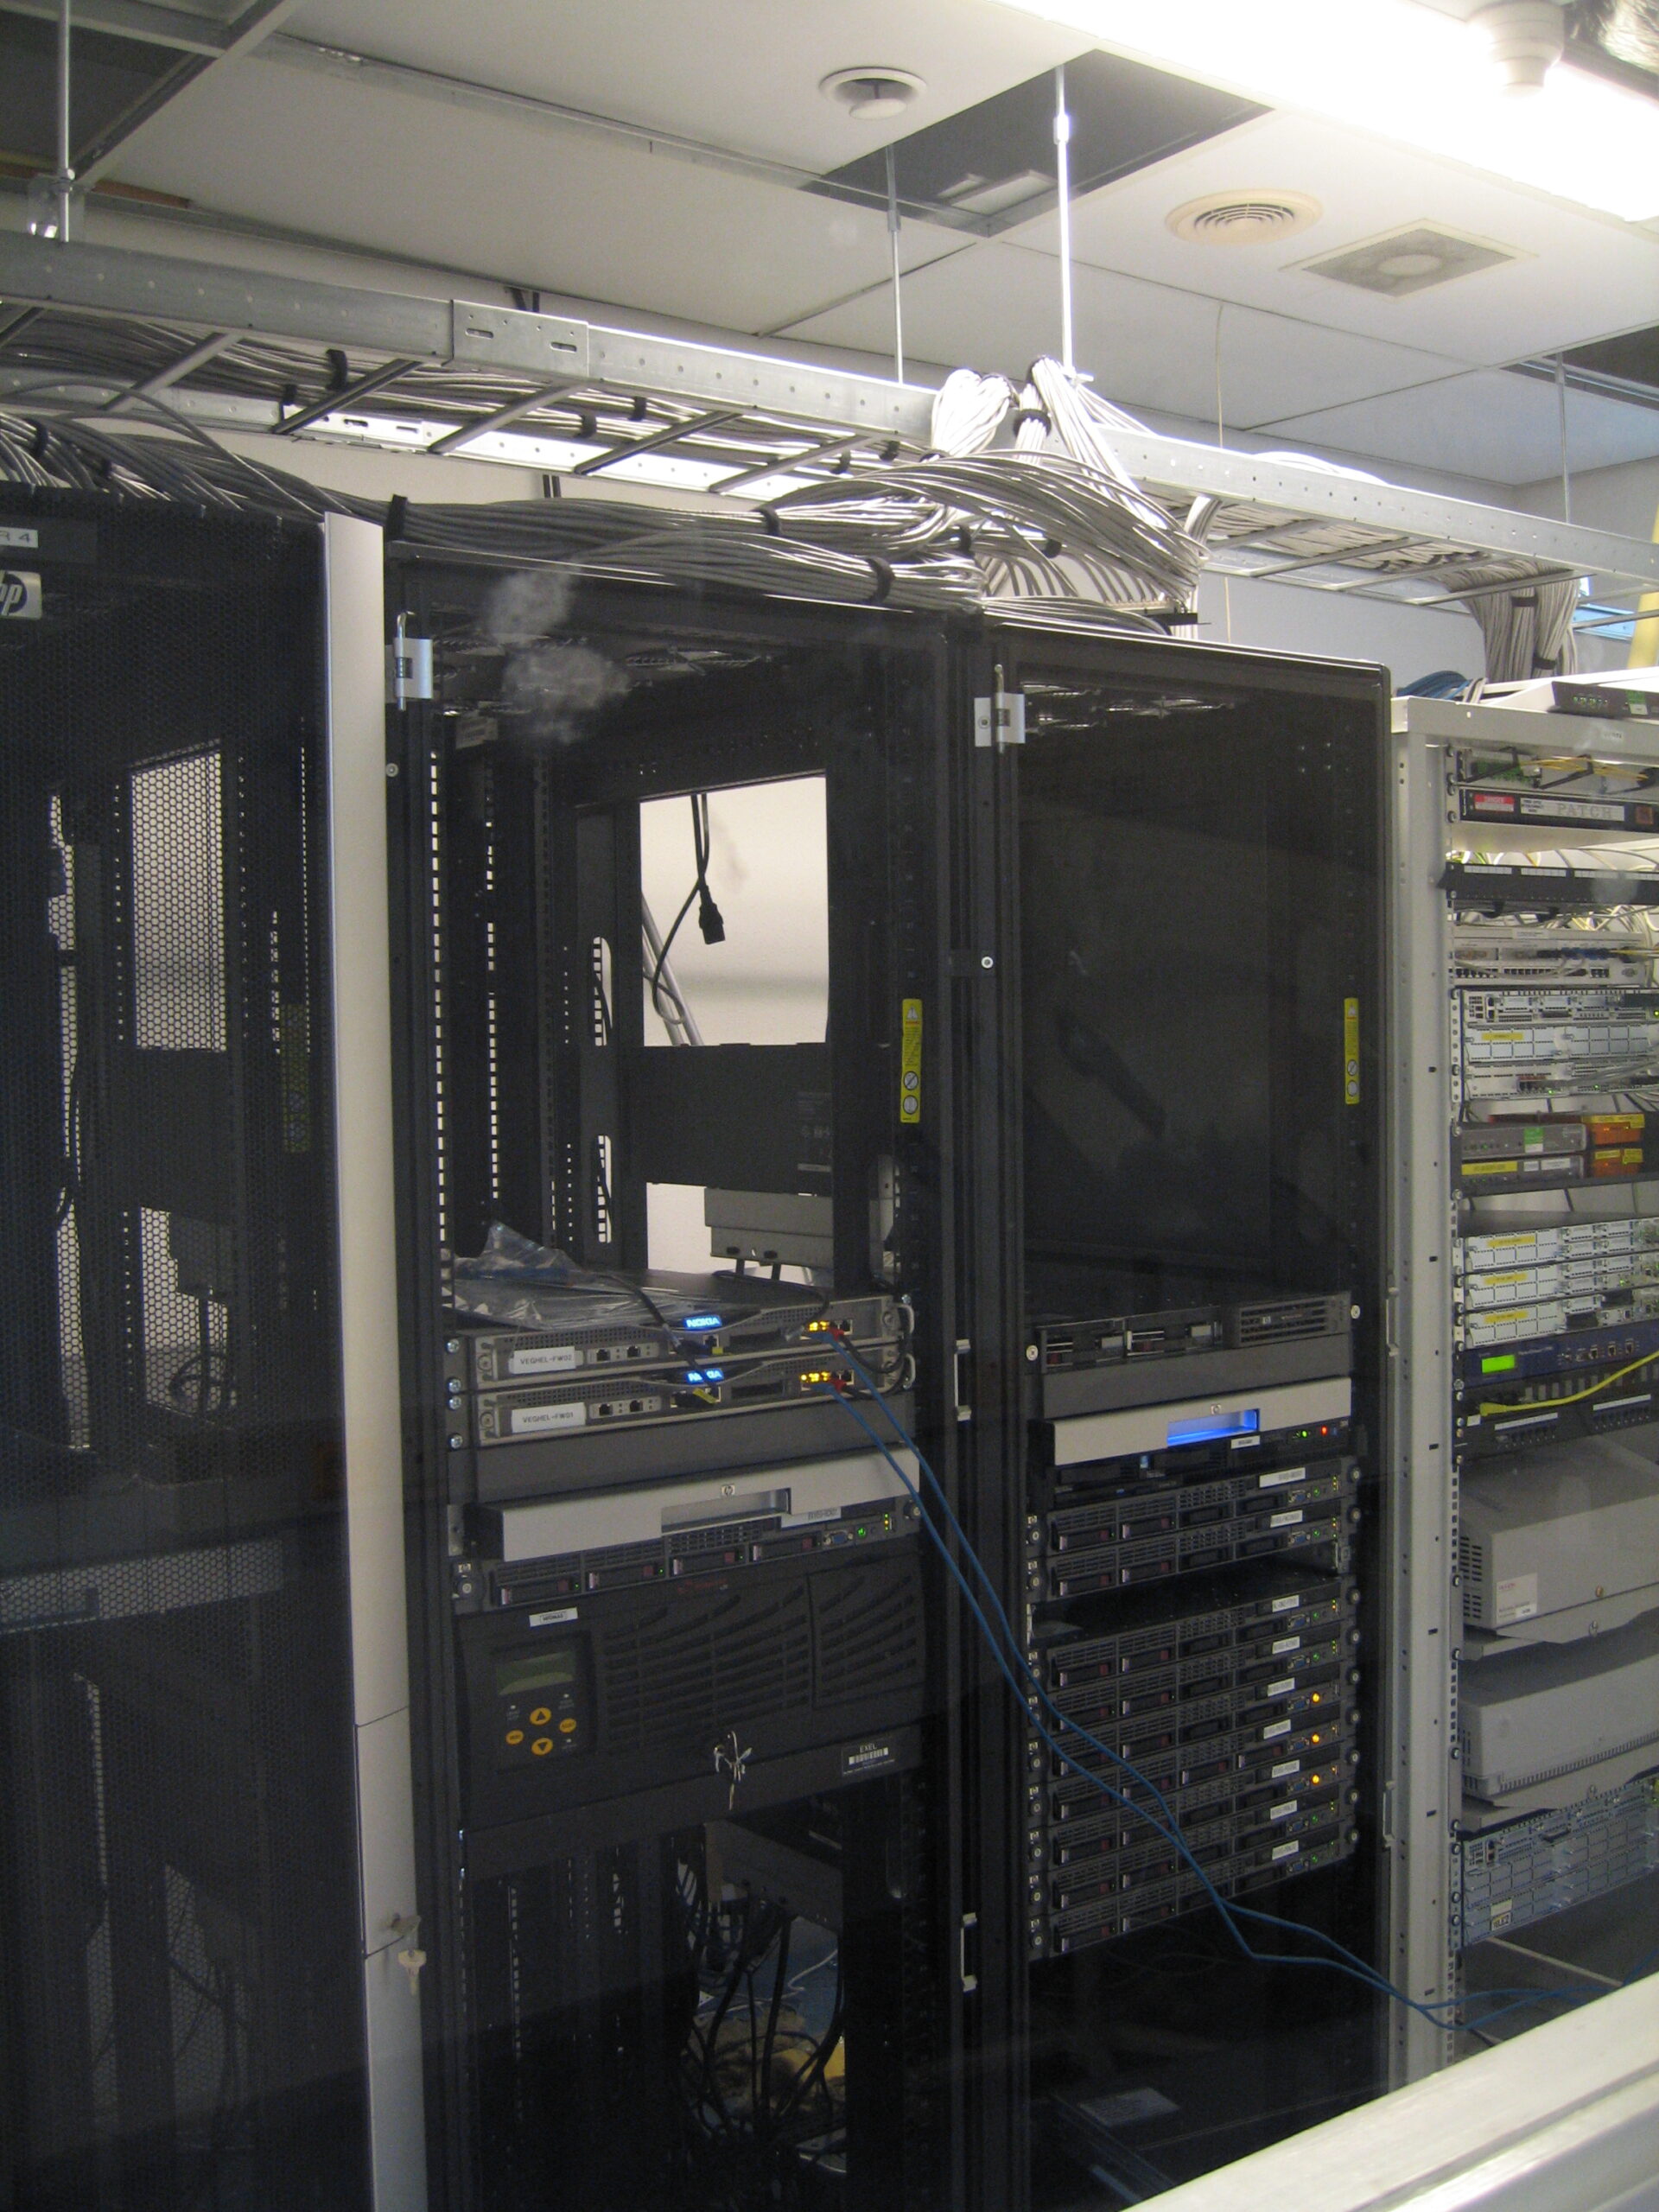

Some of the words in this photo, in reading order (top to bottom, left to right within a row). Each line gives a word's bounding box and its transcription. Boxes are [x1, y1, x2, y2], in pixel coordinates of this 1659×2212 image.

[1558, 803, 1611, 818] PATCH
[686, 1317, 721, 1328] NOKIA
[859, 1743, 877, 1753] EXEL
